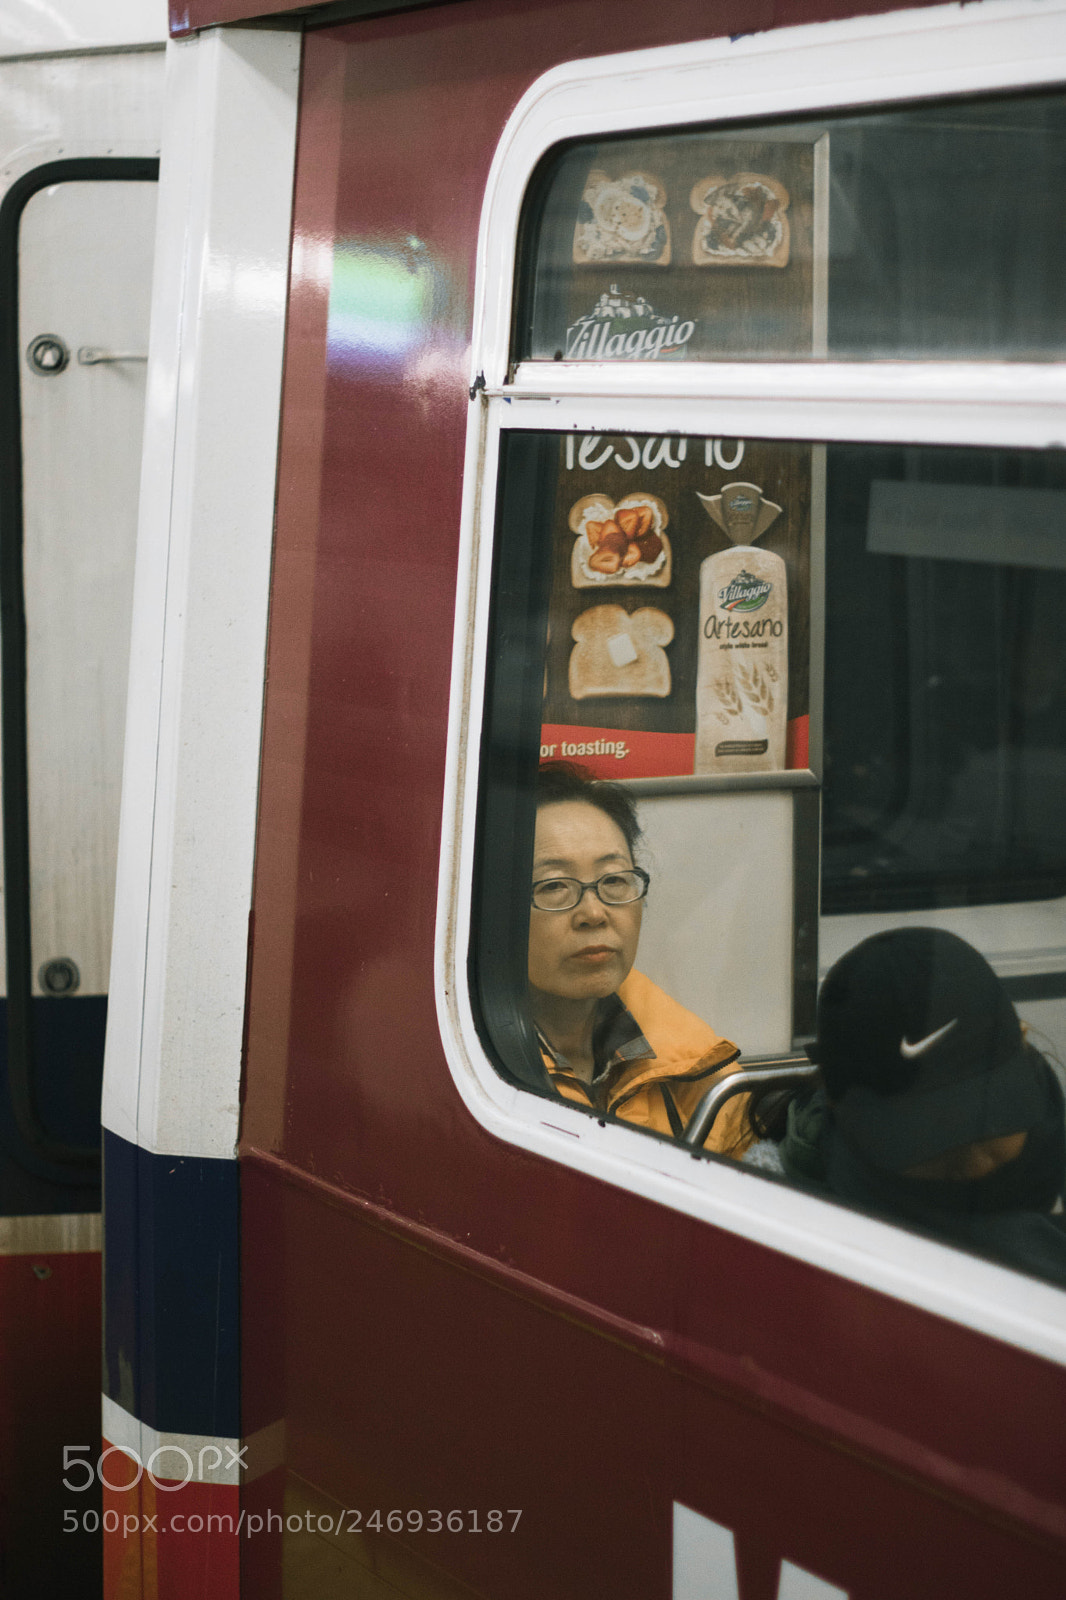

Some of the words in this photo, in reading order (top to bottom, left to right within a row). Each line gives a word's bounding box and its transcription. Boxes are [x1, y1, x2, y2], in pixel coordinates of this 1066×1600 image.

[566, 315, 696, 359] Villaggio
[719, 583, 771, 602] Villaggio
[704, 614, 783, 639] Artesano
[561, 738, 630, 759] toasting.
